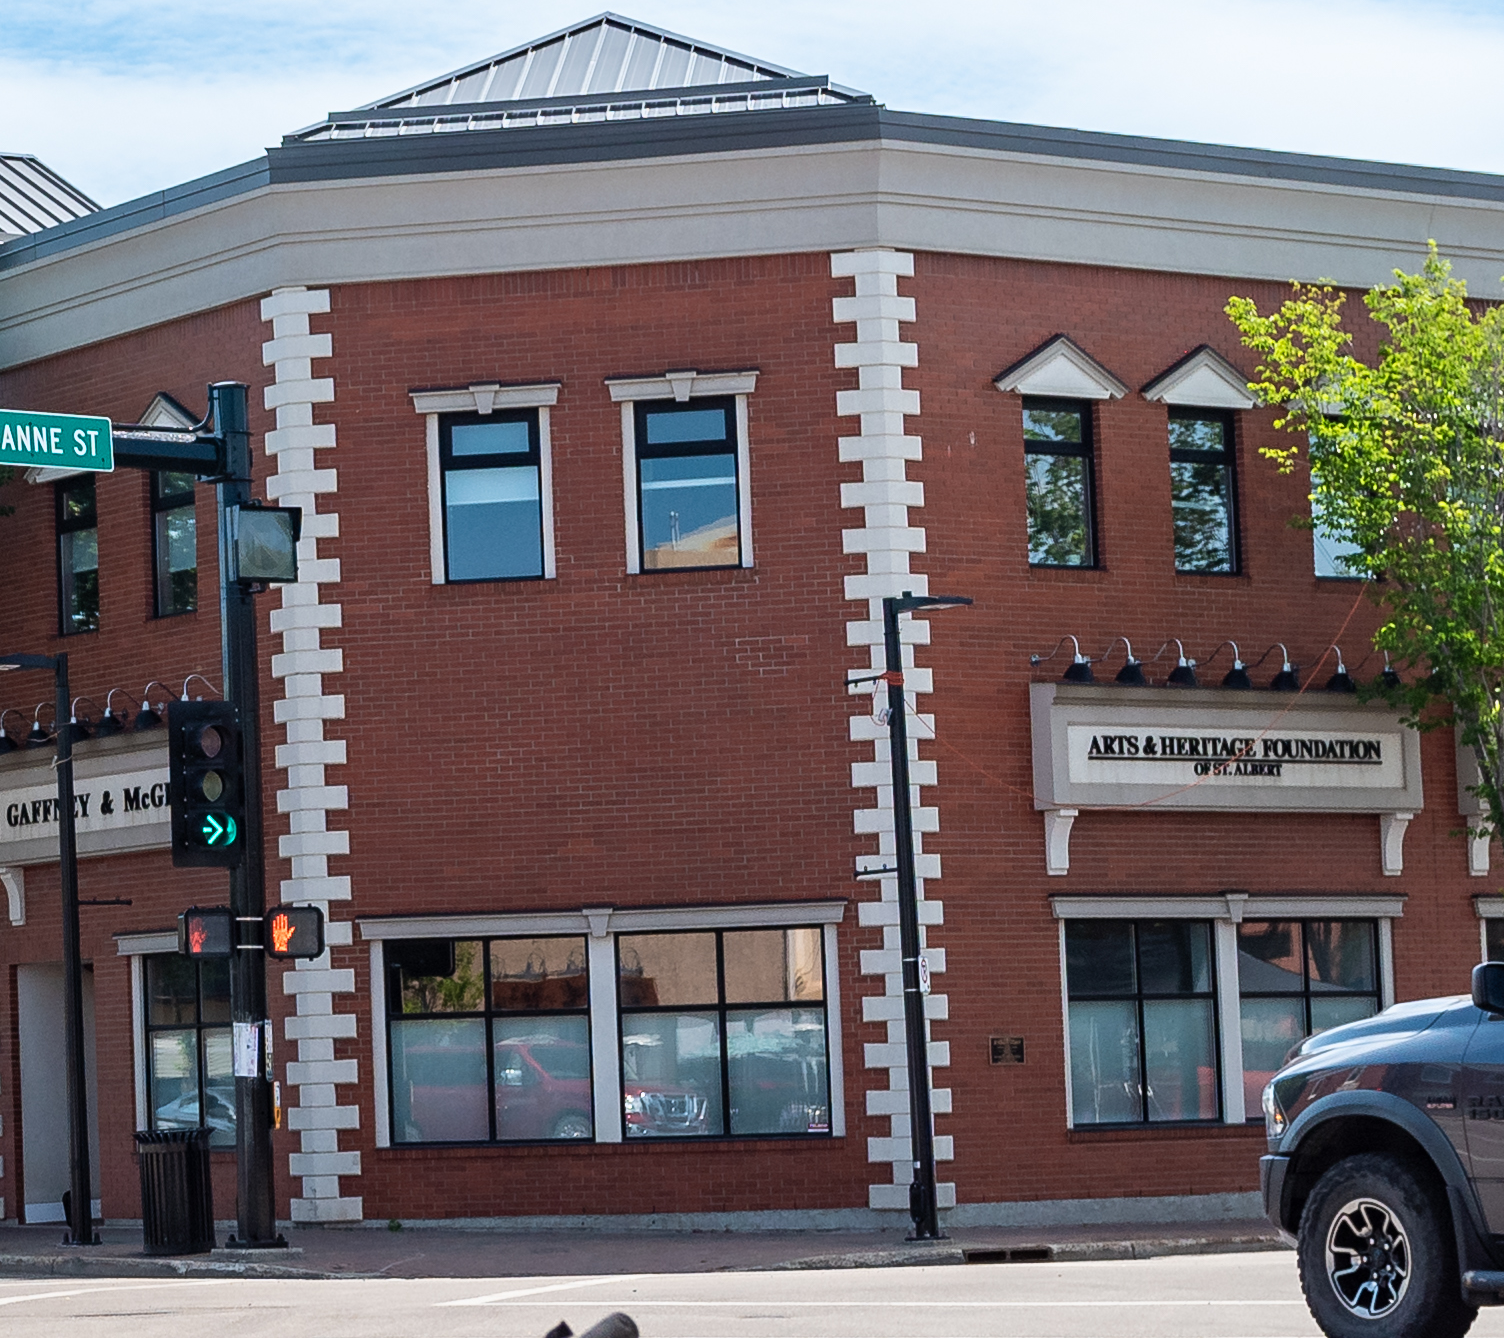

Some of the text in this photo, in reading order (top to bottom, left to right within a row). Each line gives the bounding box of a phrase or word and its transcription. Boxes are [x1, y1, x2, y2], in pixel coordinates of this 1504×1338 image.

[1, 424, 64, 455] ANNE
[73, 429, 99, 457] ST
[1088, 735, 1382, 760] ARTS & HERITAGE FOUNDATION
[1193, 761, 1283, 777] OF ST. ALBERT
[100, 790, 115, 815] &
